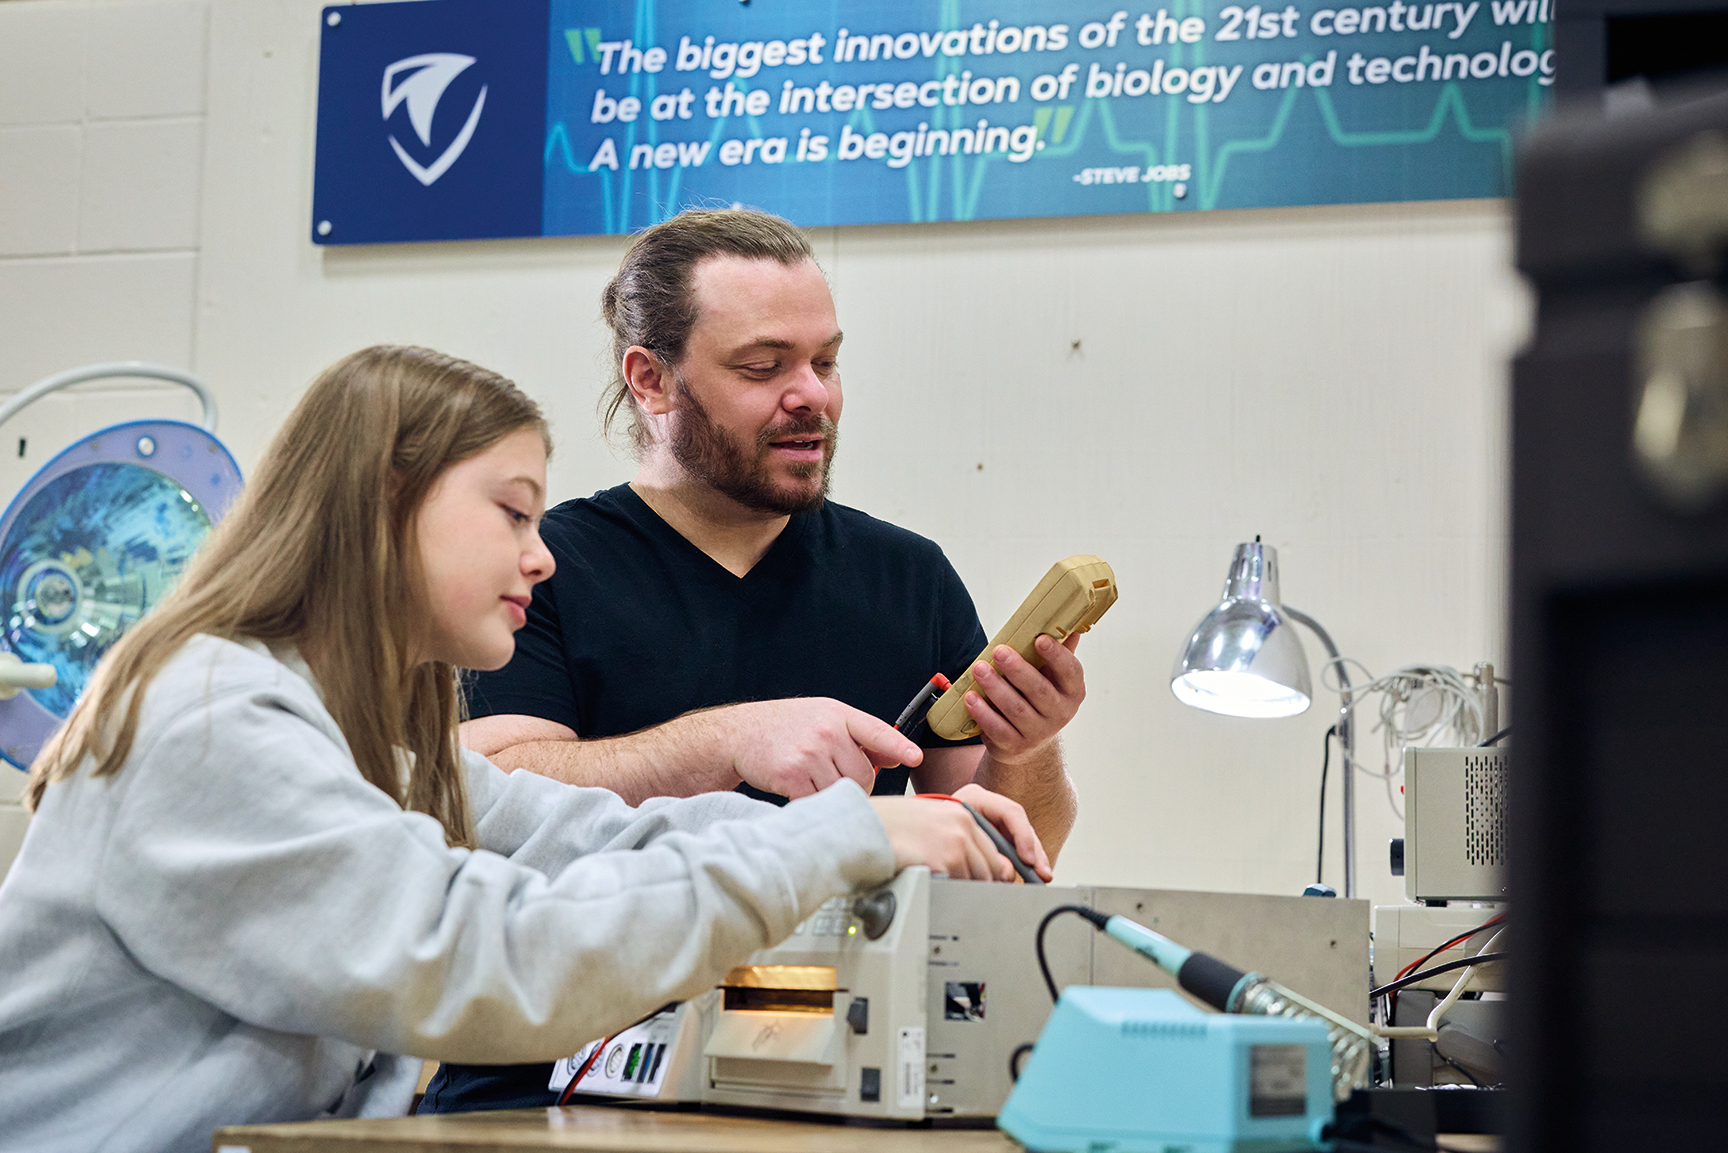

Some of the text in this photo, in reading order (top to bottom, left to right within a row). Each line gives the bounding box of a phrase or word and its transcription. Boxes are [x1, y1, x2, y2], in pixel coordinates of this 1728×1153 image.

[676, 33, 826, 78] biggest
[834, 19, 1069, 62] innovations
[1079, 11, 1129, 48] of
[1135, 9, 1206, 45] the
[1215, 5, 1300, 41] 21st
[1310, 0, 1479, 39] century
[591, 89, 641, 123] be
[650, 87, 694, 120] at
[704, 83, 770, 117] the
[778, 71, 1020, 113] intersection
[1030, 64, 1080, 101] of
[1085, 59, 1243, 103] biology
[1252, 50, 1337, 90] and
[588, 138, 619, 171] A
[628, 139, 711, 170] new
[719, 136, 788, 165] era
[797, 127, 829, 162] is
[1141, 163, 1191, 182] JOBS
